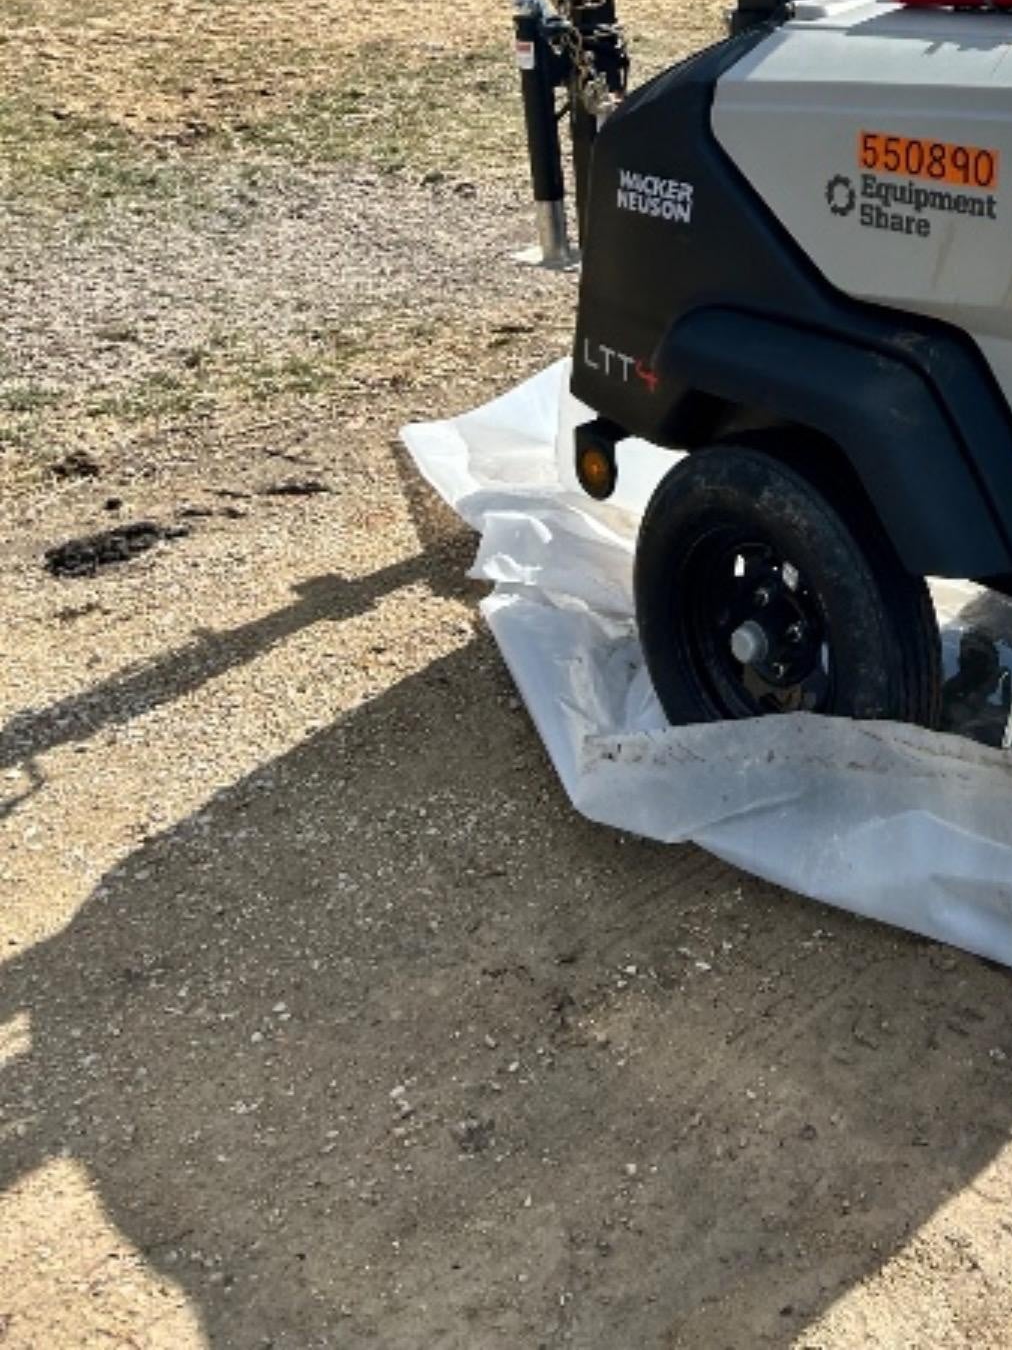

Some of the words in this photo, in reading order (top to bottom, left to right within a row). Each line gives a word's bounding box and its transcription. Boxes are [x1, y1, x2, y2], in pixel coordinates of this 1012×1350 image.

[862, 134, 994, 187] 550890
[616, 188, 692, 223] NEUSON
[619, 169, 694, 203] WACKER
[861, 173, 997, 219] Equipment
[860, 204, 931, 237] Share
[583, 338, 659, 392] LTT4
